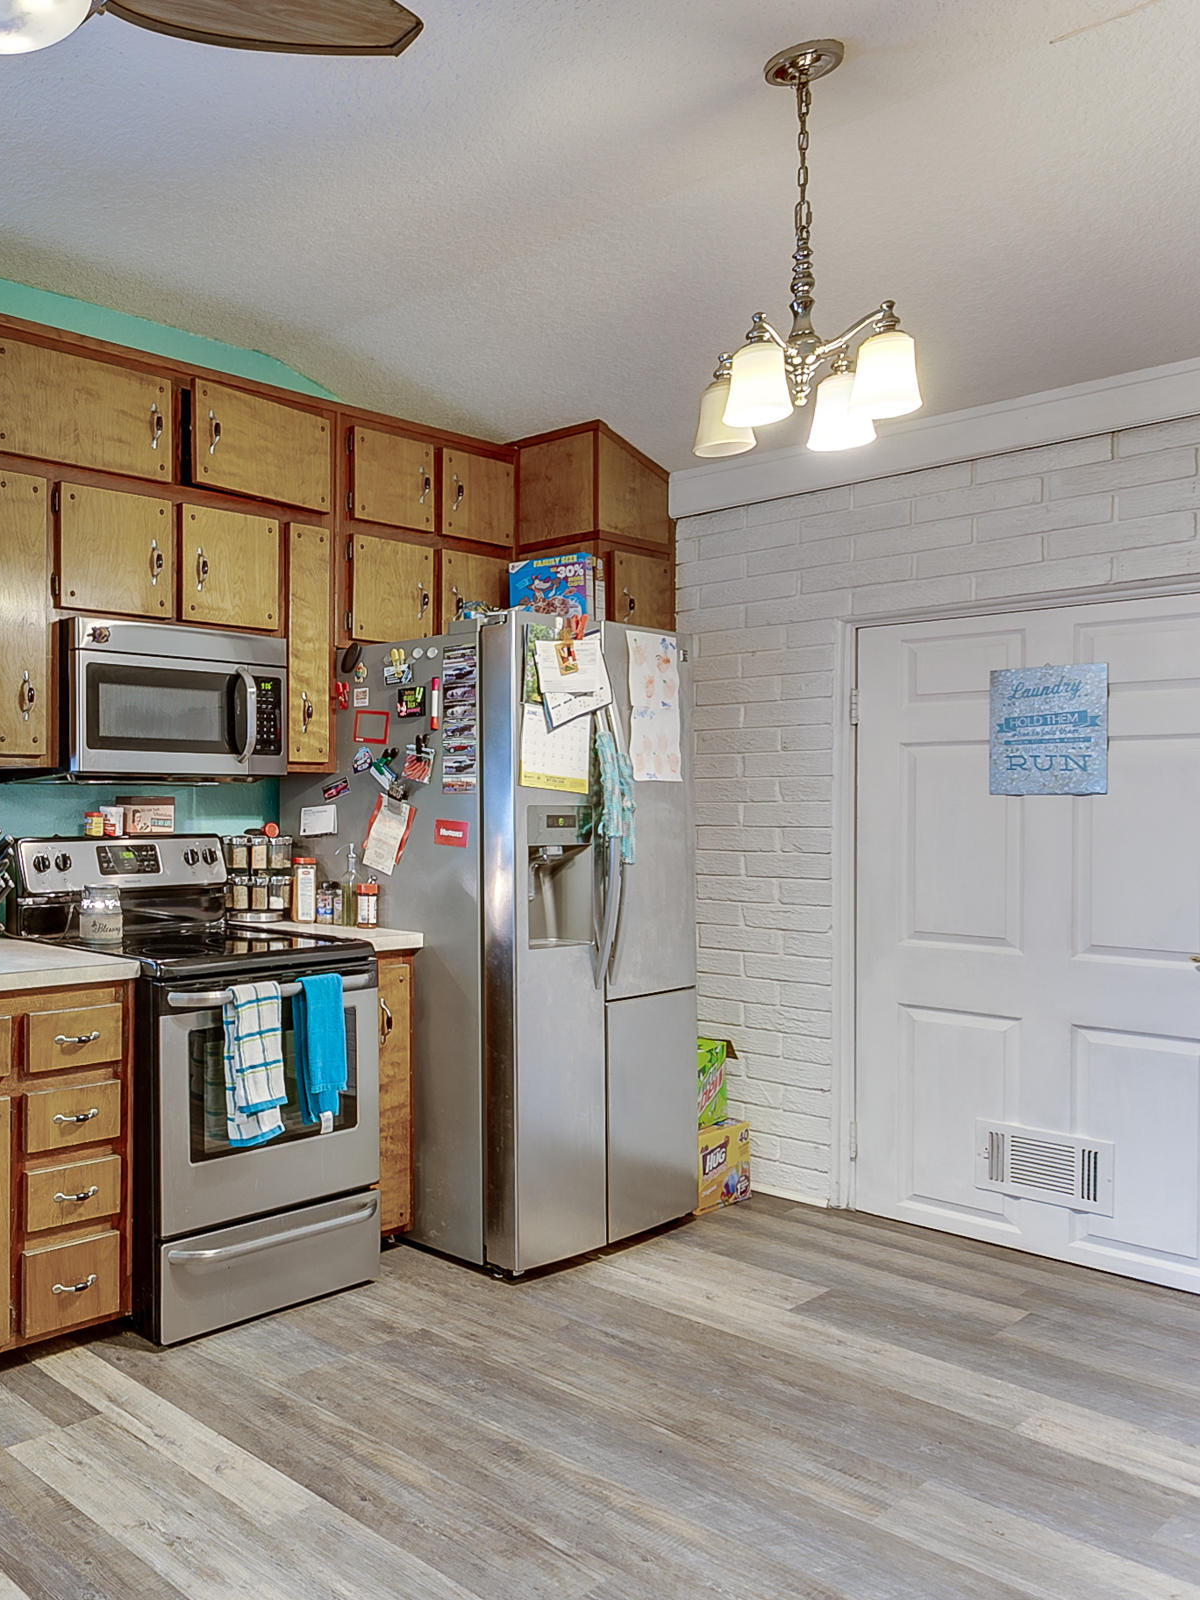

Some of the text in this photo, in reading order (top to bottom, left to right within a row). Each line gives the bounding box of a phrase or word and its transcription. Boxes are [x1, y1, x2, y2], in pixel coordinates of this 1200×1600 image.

[556, 564, 584, 578] 30%
[1008, 676, 1081, 700] Laundry
[1010, 713, 1079, 727] HOLD THEM
[1004, 754, 1092, 772] RUN
[705, 1147, 726, 1173] HUG
